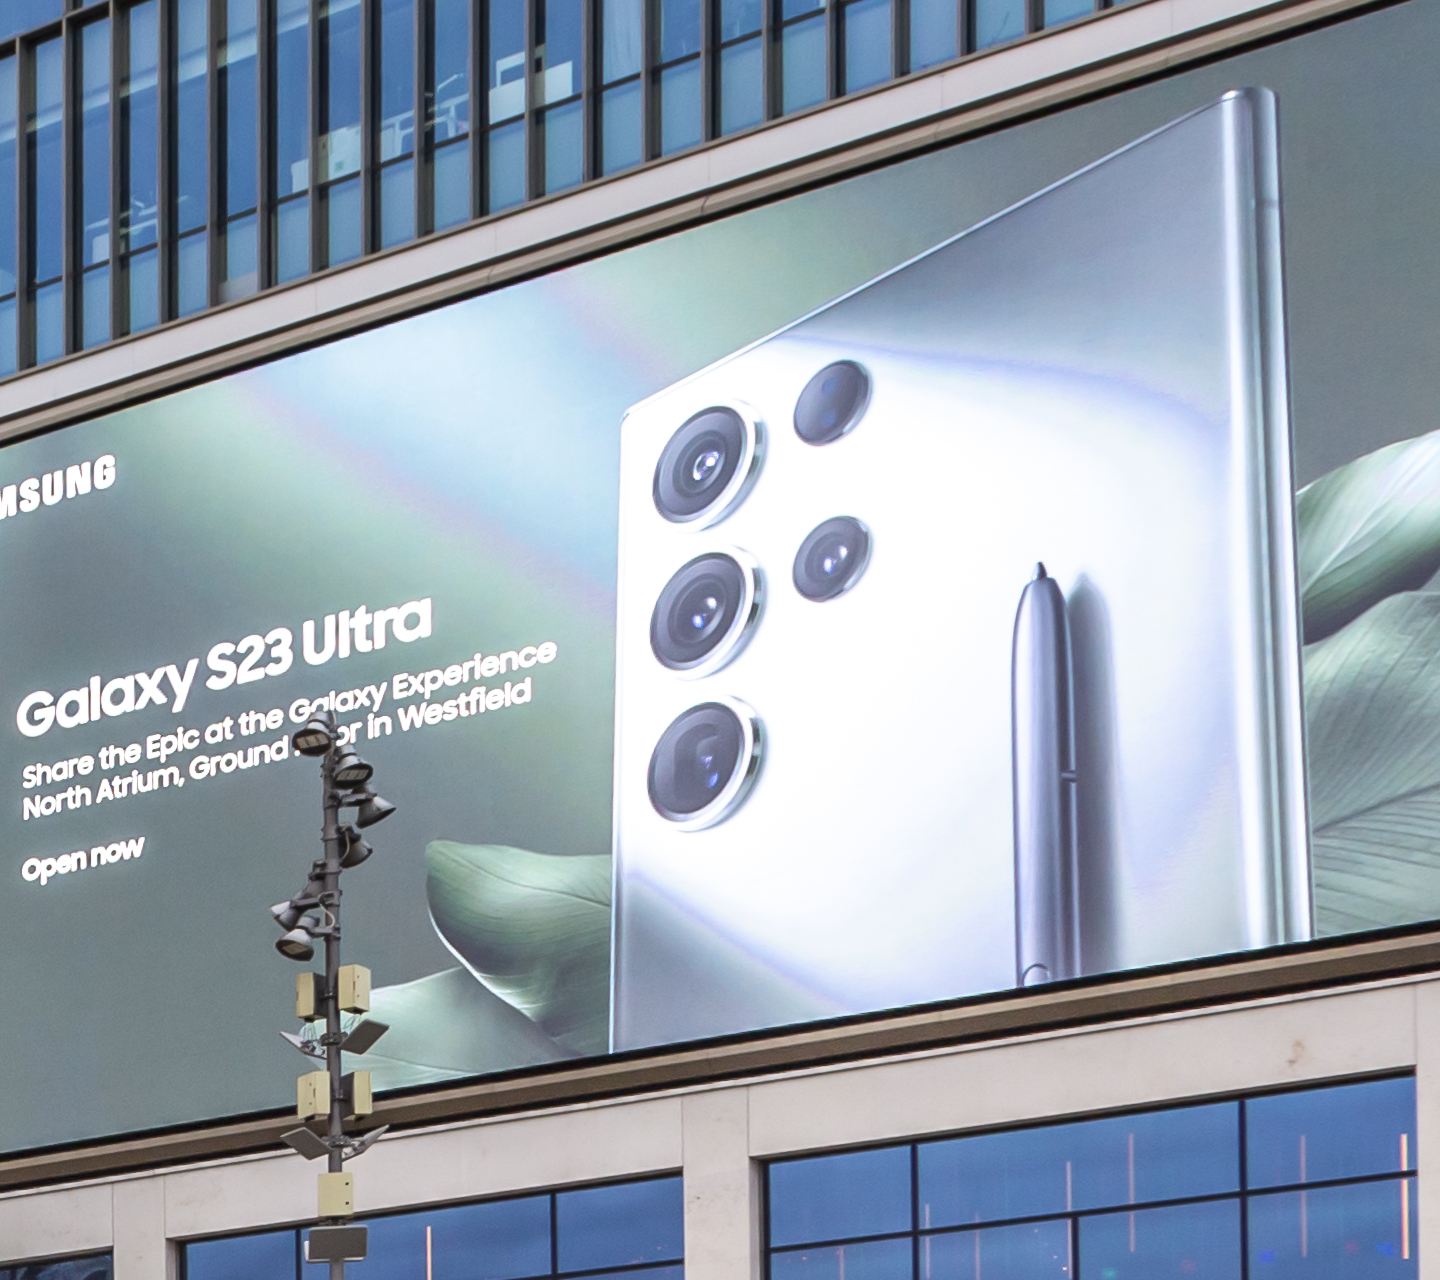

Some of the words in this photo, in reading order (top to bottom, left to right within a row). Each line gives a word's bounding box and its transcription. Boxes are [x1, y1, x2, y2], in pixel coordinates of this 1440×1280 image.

[16, 658, 200, 738] Galaxy
[205, 627, 294, 692] S23
[302, 597, 433, 667] Ultra
[22, 749, 94, 790] Share
[99, 736, 142, 770] the
[147, 724, 200, 770] Epic
[205, 716, 234, 745] at
[239, 703, 284, 737] the
[289, 680, 388, 722] Galaxy
[392, 639, 558, 701] Experience
[22, 782, 92, 820] North
[95, 764, 185, 806] Atrium,
[189, 736, 290, 781] Ground
[368, 714, 393, 740] in
[397, 677, 533, 731] Westfield
[21, 847, 86, 885] Open
[90, 835, 146, 868] now
